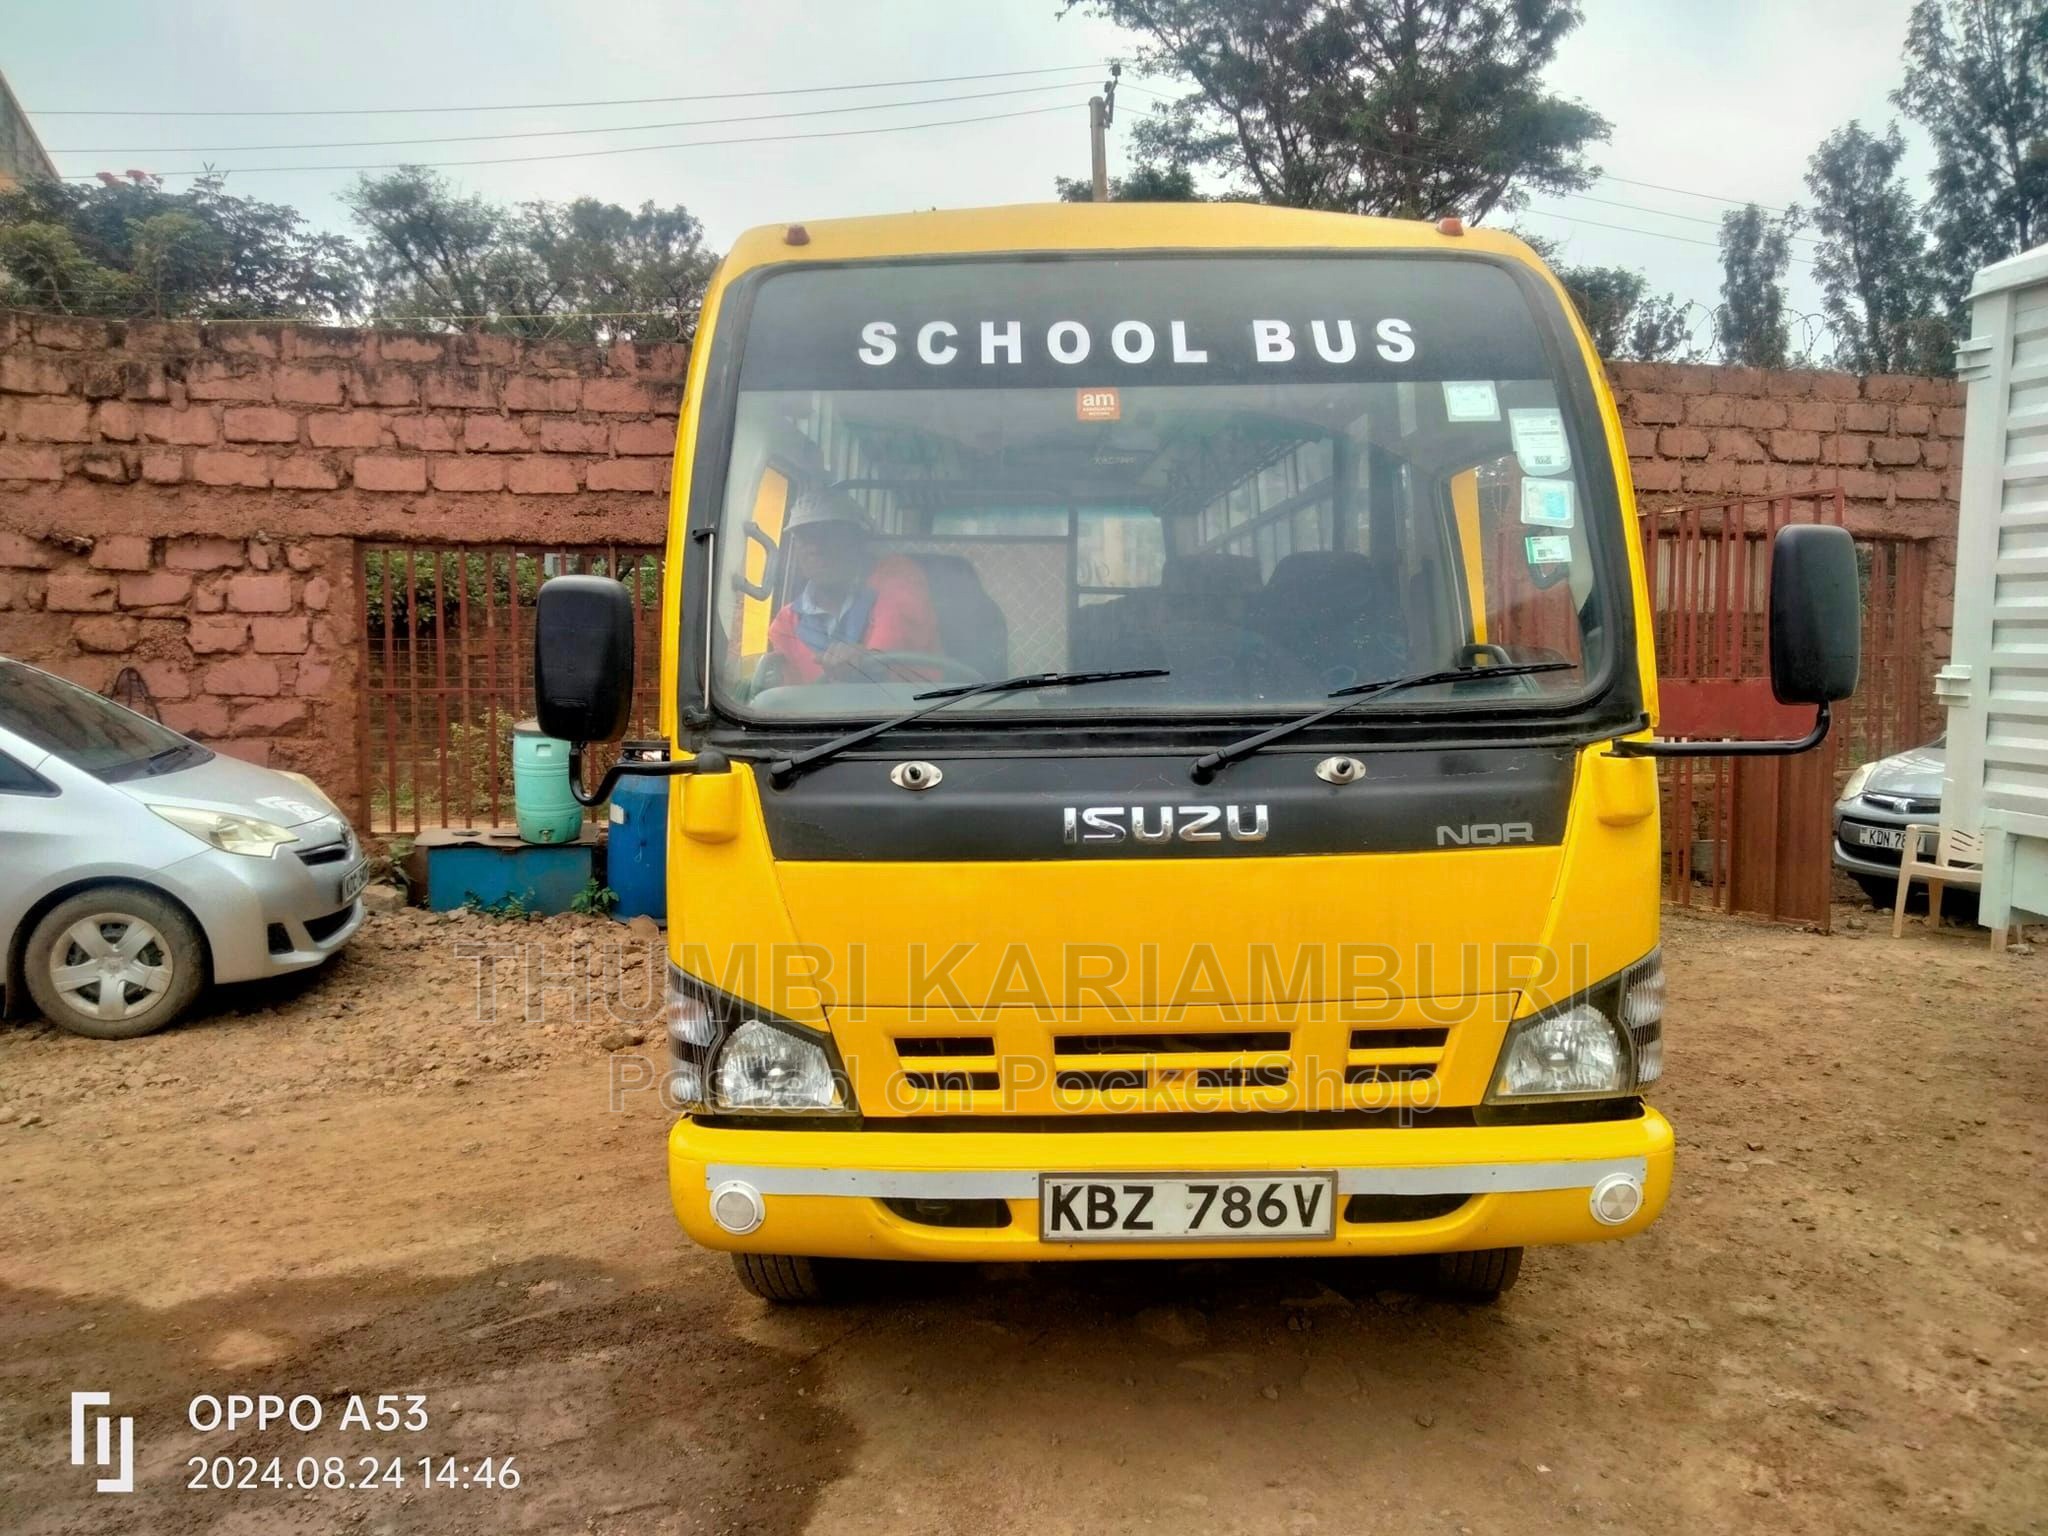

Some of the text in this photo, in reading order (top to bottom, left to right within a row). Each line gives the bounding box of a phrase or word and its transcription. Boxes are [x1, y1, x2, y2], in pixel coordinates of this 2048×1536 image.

[858, 318, 1416, 366] SCHOOL BUS
[1082, 393, 1115, 407] am
[1063, 804, 1535, 847] ISUZU NQR
[1869, 829, 1891, 847] KDN
[1050, 1183, 1325, 1232] KBZ 786V
